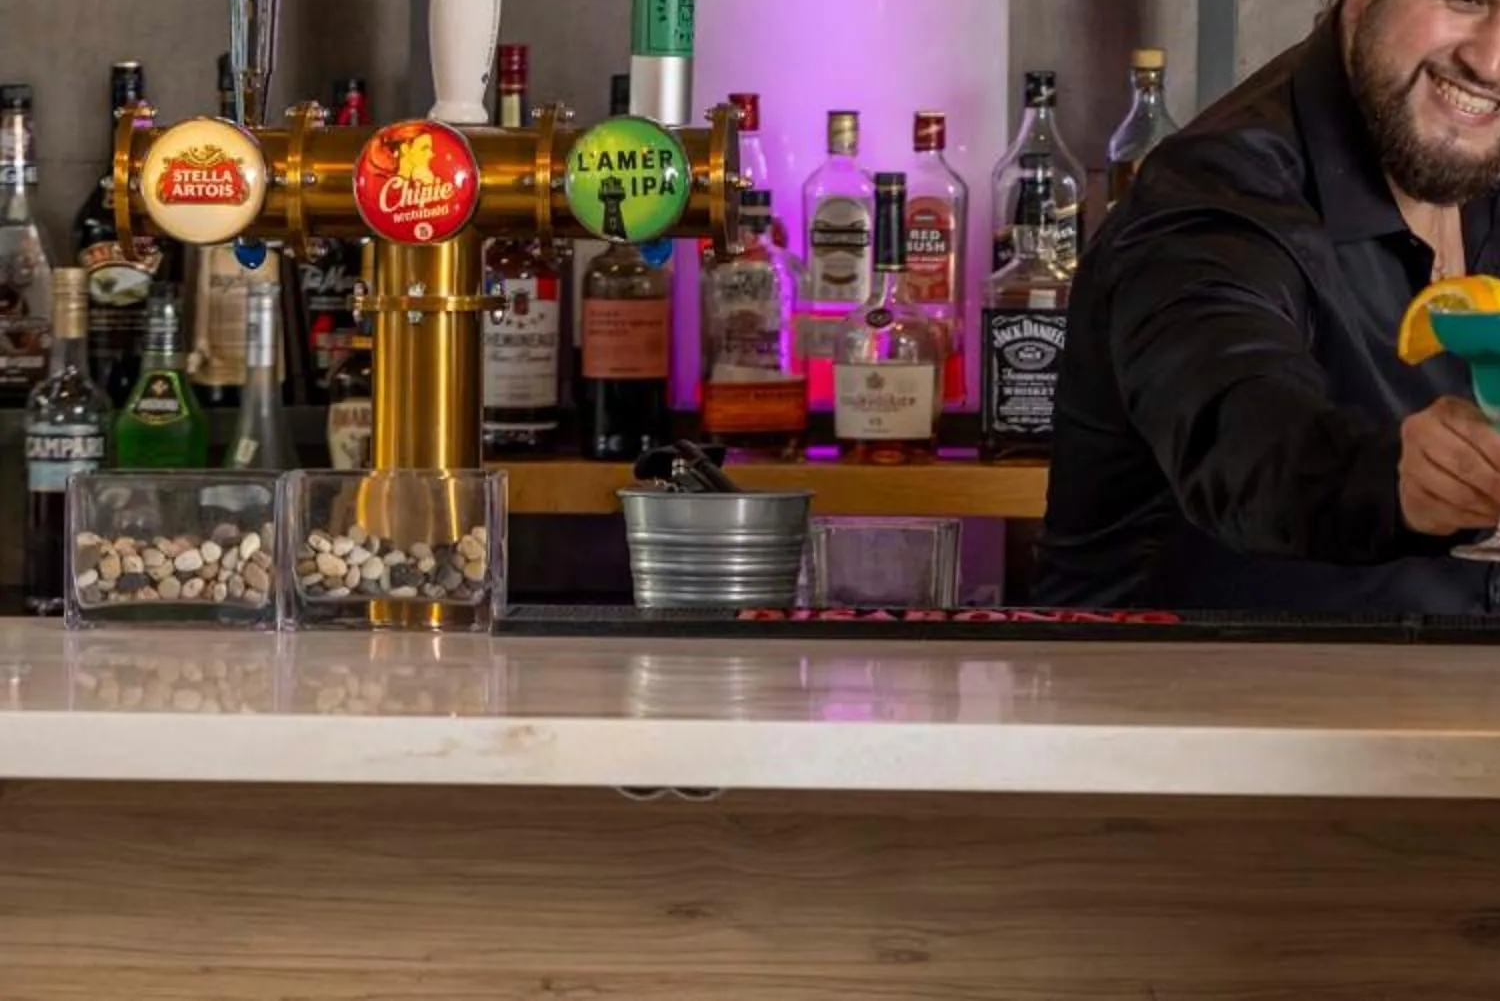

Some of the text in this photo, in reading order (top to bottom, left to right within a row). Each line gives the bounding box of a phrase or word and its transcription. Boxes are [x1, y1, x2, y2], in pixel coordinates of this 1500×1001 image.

[577, 150, 674, 172] L'AMER
[172, 169, 234, 183] STELLA
[630, 176, 676, 198] IPA
[171, 183, 235, 197] ARTOIS
[379, 176, 455, 213] Chipie
[909, 229, 941, 240] RED
[992, 325, 1022, 349] JACK
[26, 436, 105, 459] CAMPARI
